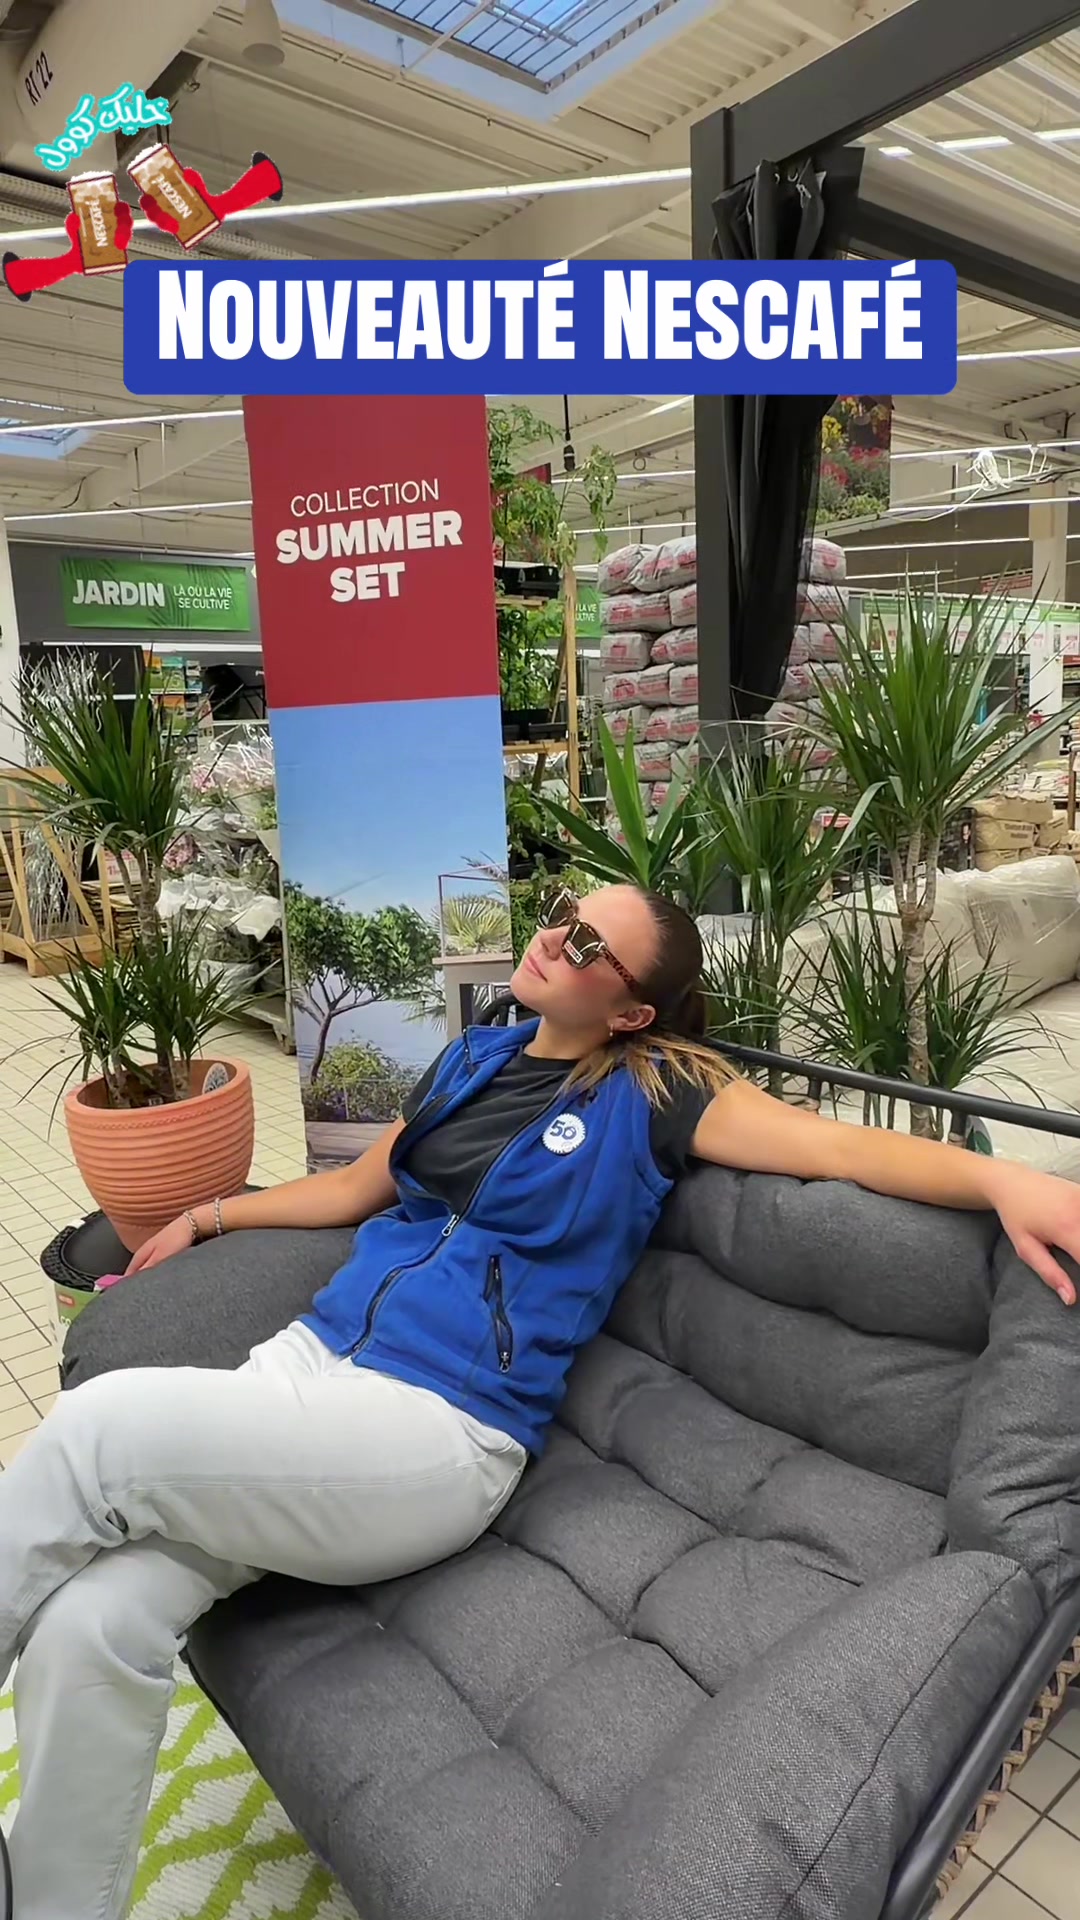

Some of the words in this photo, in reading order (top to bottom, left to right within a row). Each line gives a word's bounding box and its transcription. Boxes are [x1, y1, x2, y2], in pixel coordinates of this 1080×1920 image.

[25, 71, 41, 106] RT
[36, 51, 53, 89] 22
[290, 478, 440, 517] COLLECTION
[275, 510, 463, 564] SUMMER
[72, 579, 165, 607] JARDIN
[203, 587, 217, 598] LA
[217, 587, 233, 599] VIE
[330, 561, 406, 603] SET
[178, 597, 191, 609] SE
[192, 598, 231, 610] CULTIVE
[549, 1119, 577, 1140] 50
